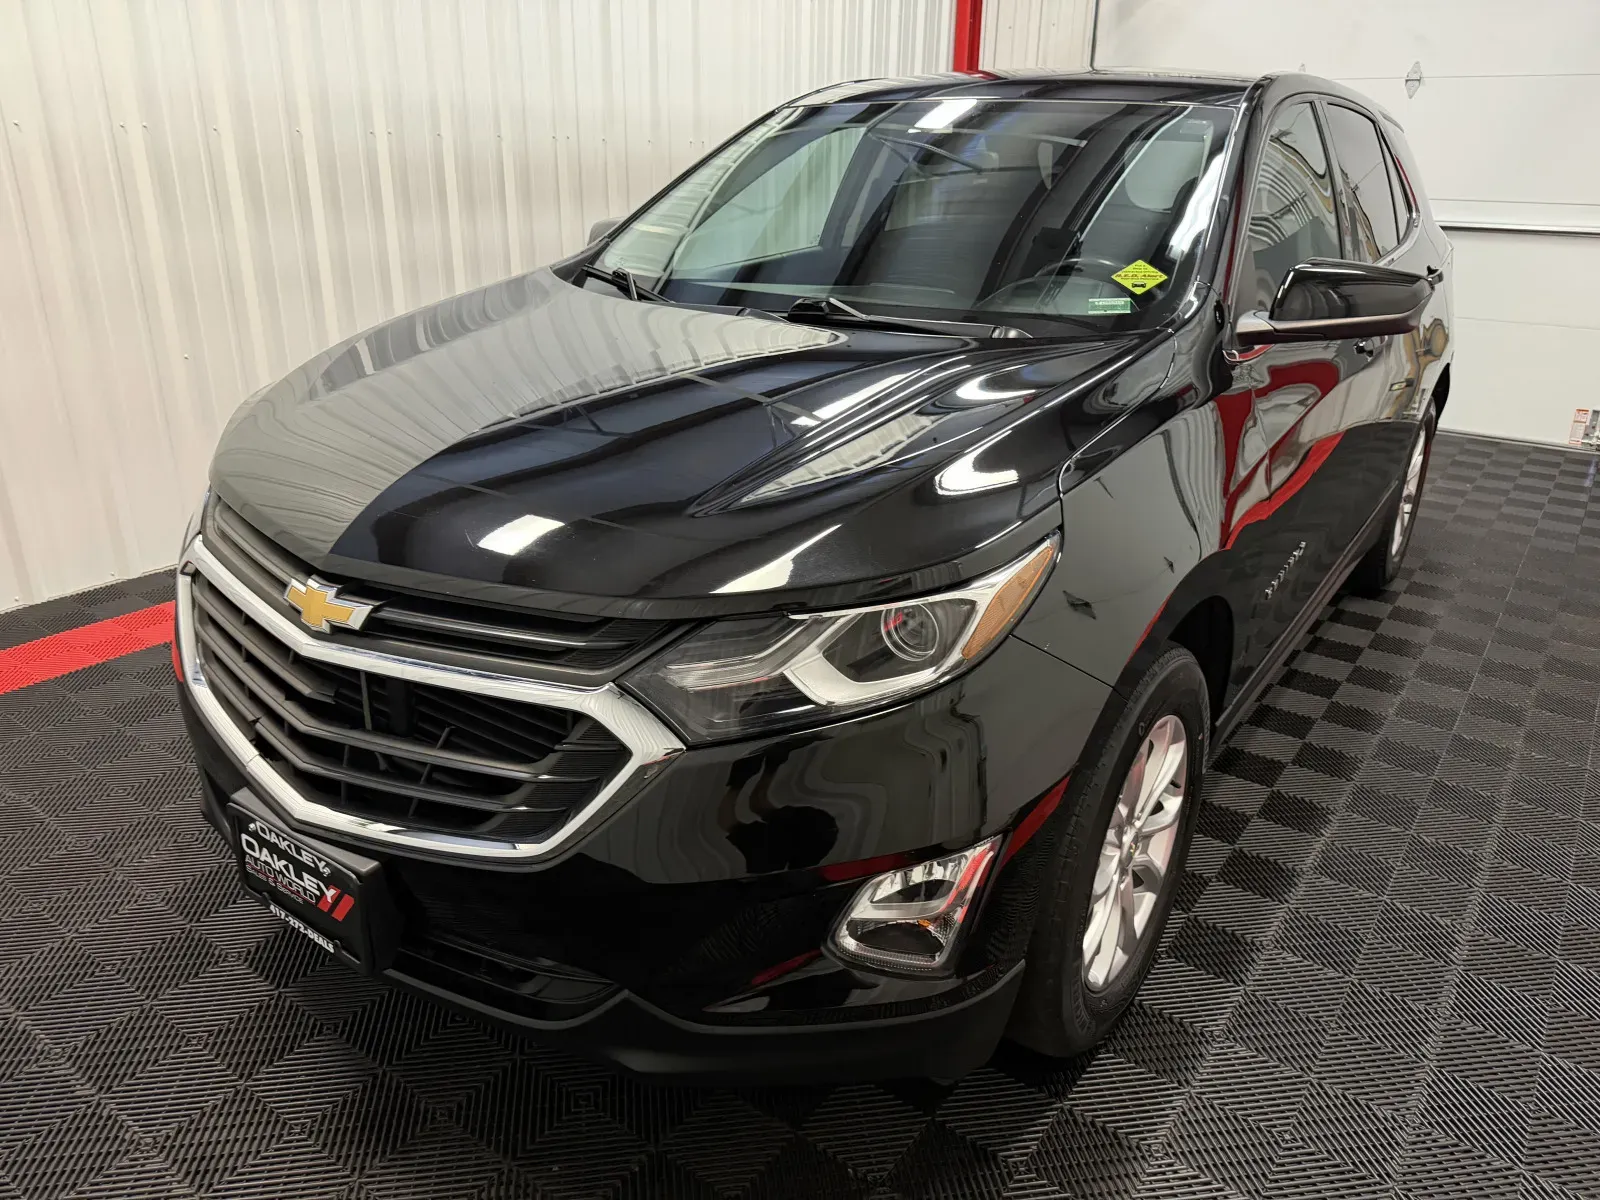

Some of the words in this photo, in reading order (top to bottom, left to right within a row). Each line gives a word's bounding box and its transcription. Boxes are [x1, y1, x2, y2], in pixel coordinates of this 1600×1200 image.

[241, 833, 337, 903] OAKLEY
[255, 820, 327, 873] OAKLEY
[245, 854, 275, 878] AUTO
[275, 871, 316, 903] WORLD
[270, 904, 335, 954] 417-272-DEALS
